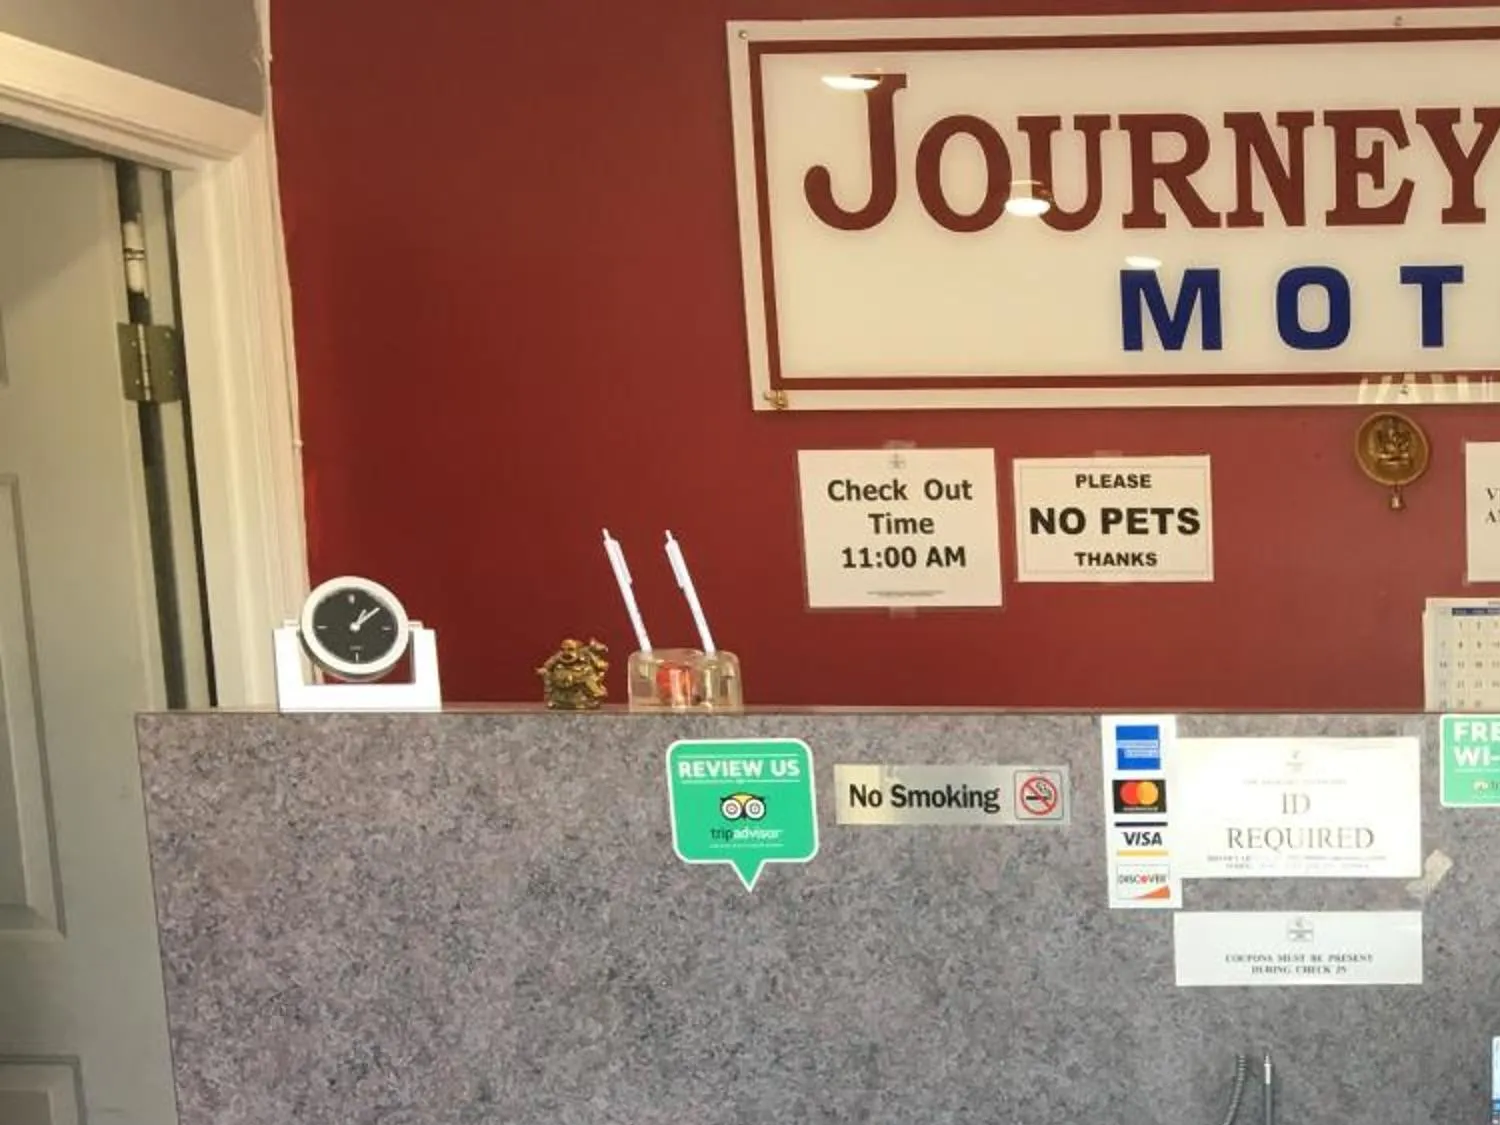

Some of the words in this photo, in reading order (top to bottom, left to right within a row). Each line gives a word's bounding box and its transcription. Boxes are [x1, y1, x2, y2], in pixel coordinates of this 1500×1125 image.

[827, 479, 907, 501] Check
[924, 478, 973, 501] Out
[1075, 474, 1152, 489] PLEASE
[868, 513, 935, 534] Time
[1029, 507, 1086, 535] NO
[1100, 506, 1201, 535] PETS
[842, 547, 917, 569] 11:00
[926, 546, 966, 567] AM
[1074, 551, 1158, 567] THANKS
[678, 760, 763, 779] REVIEW
[771, 759, 801, 778] US
[849, 784, 884, 808] No
[890, 783, 1001, 814] Smoking
[1281, 792, 1311, 815] ID
[1123, 831, 1163, 846] VISA
[1226, 827, 1375, 853] REQUIRED
